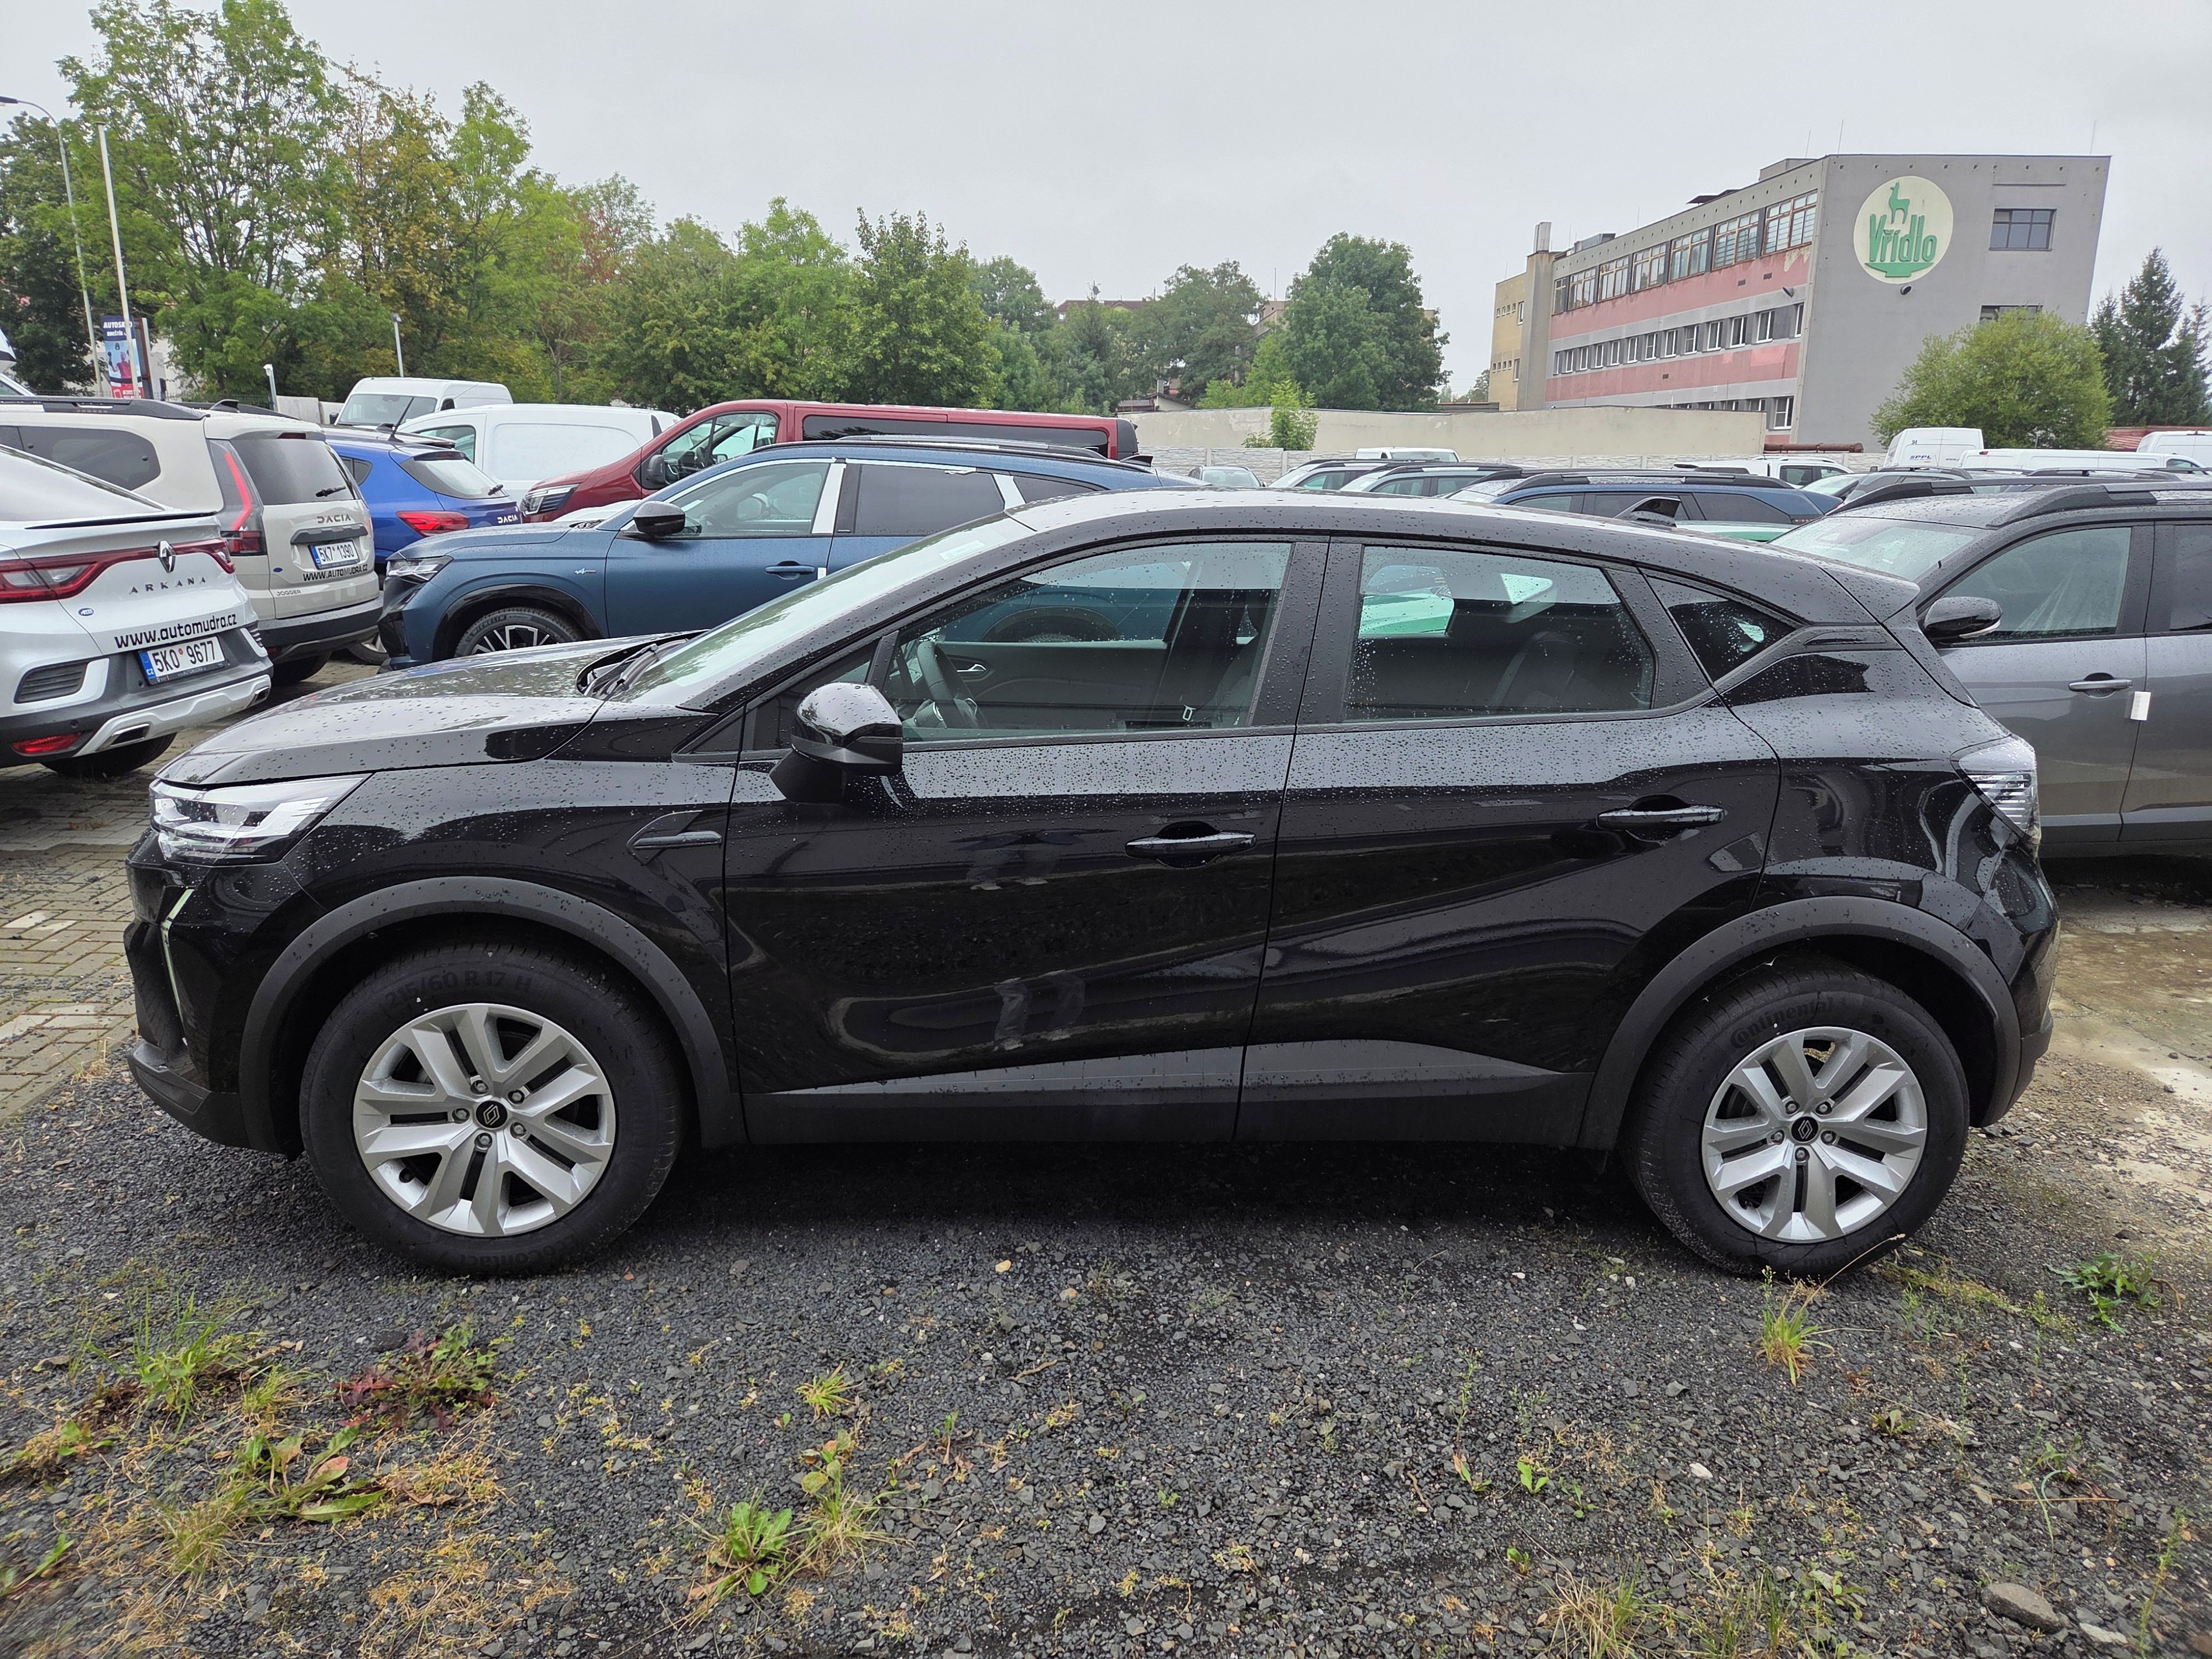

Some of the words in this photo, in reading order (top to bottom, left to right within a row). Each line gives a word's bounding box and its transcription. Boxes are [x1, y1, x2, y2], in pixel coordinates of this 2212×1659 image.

[1869, 213, 1937, 262] Vřídlo
[317, 514, 351, 524] DACIA
[497, 514, 518, 524] DACIA
[318, 546, 333, 562] 5K7
[337, 544, 354, 559] 1390
[128, 576, 206, 595] ARKANA
[114, 613, 237, 649] www.automudra.cz
[472, 615, 506, 636] MICHELIN
[152, 649, 180, 672] 5K0
[186, 640, 215, 665] 9677
[465, 971, 479, 987] R
[484, 970, 507, 987] 17
[515, 975, 533, 993] H
[1730, 996, 1834, 1049] Continental
